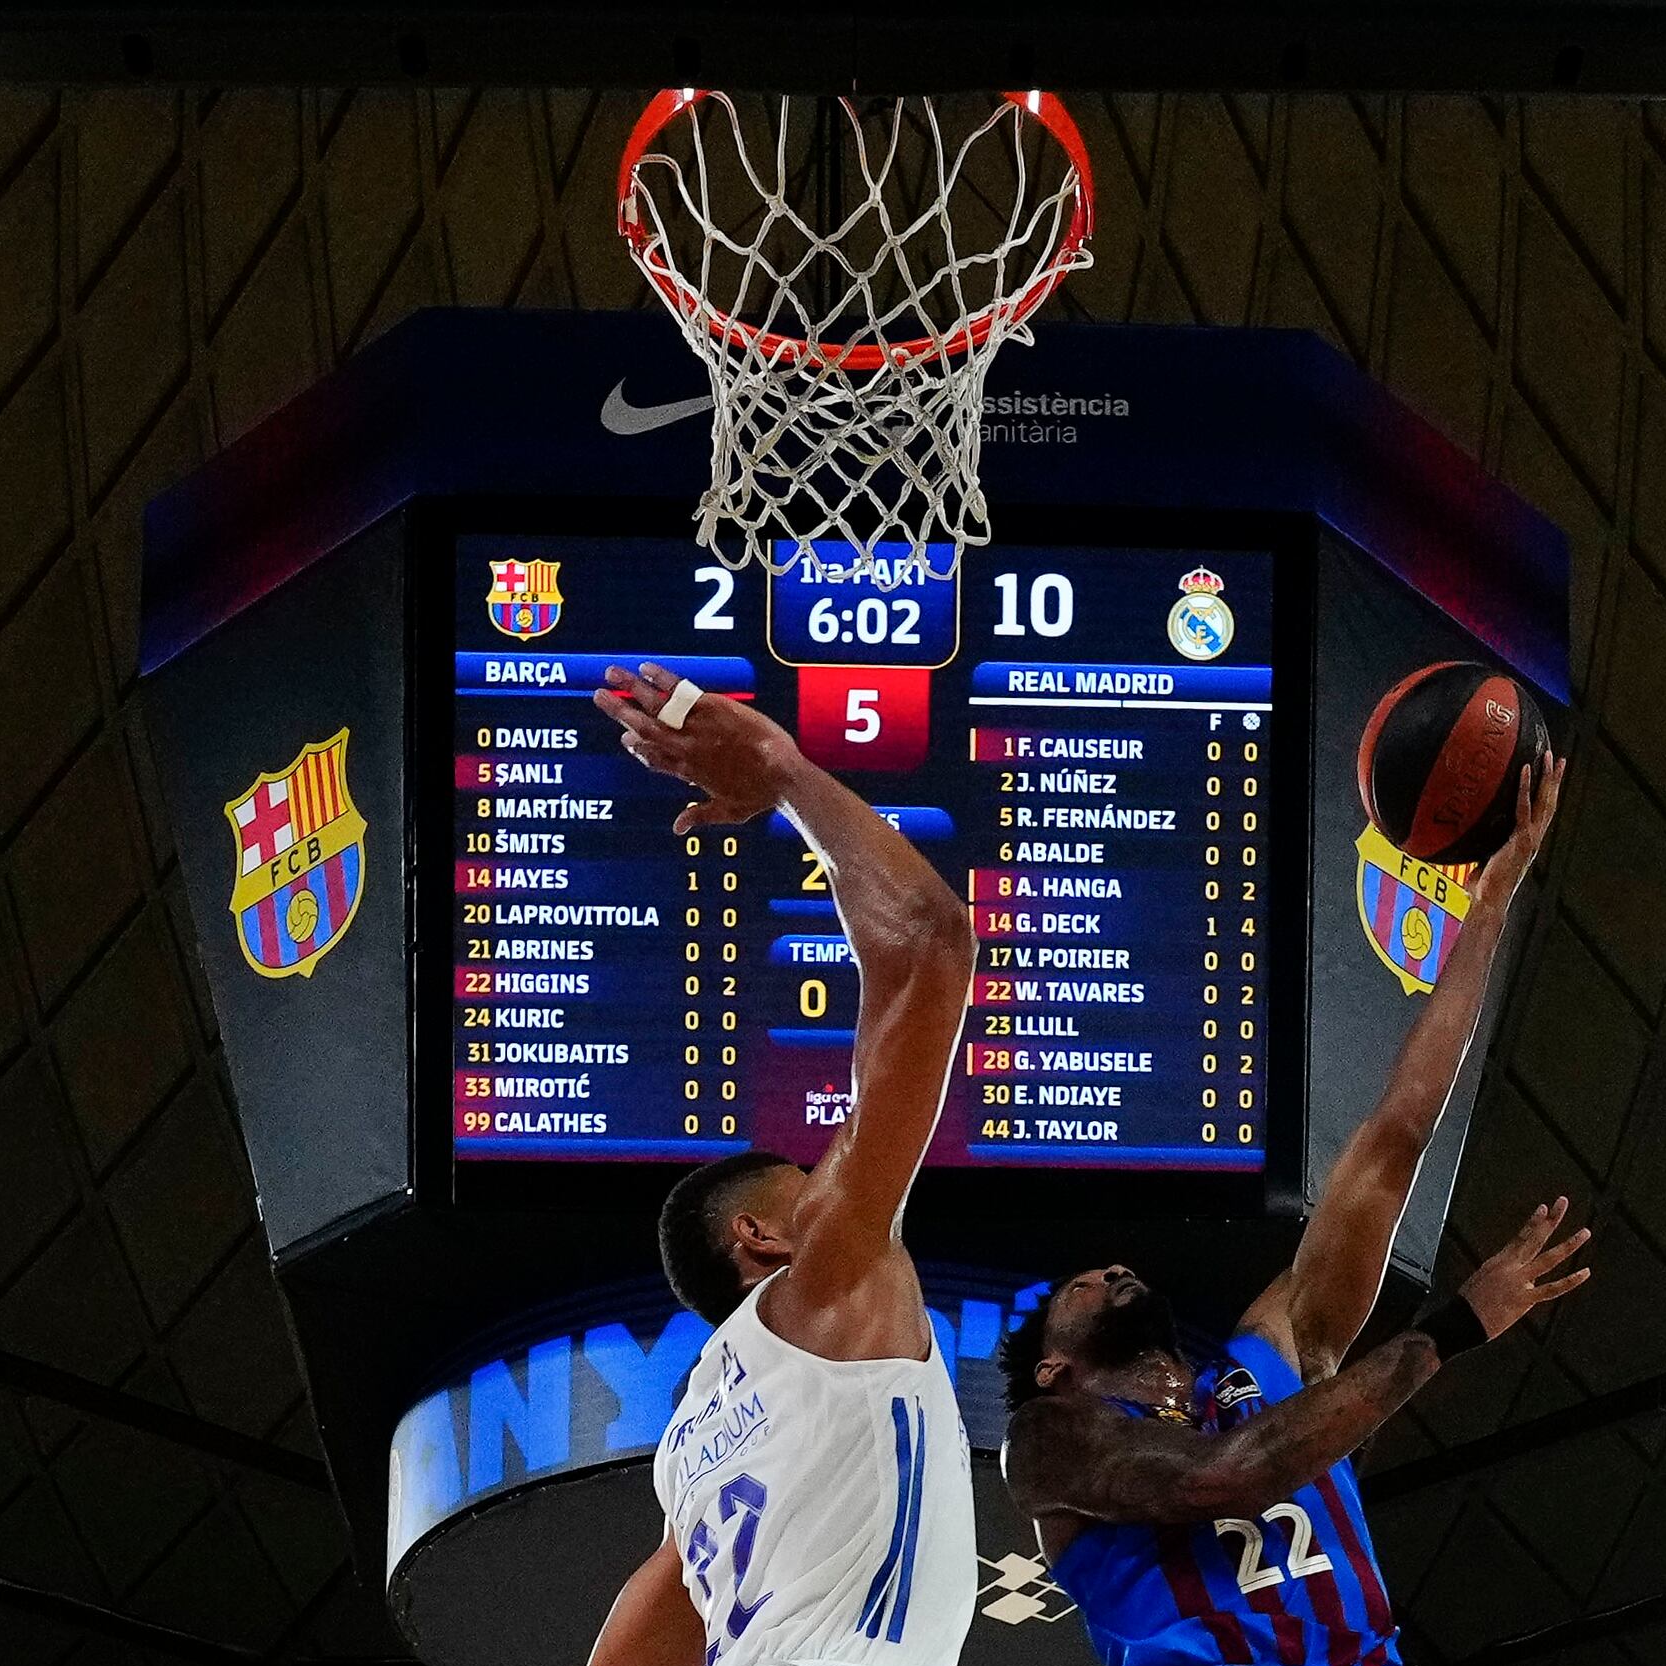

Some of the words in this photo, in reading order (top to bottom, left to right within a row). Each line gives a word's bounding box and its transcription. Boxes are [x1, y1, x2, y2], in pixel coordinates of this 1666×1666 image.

[983, 390, 1129, 417] ssistència
[981, 418, 1078, 444] anitària
[853, 558, 931, 585] PART
[693, 567, 735, 629] 2
[993, 573, 1073, 637] 10
[808, 598, 921, 644] 6:02
[485, 661, 567, 687] BARÇA
[1008, 671, 1070, 693] REAL
[1076, 672, 1174, 695] MADRID
[845, 689, 881, 743] 5
[1209, 714, 1222, 731] F
[477, 728, 491, 747] 0
[495, 729, 578, 748] DAVIES
[1004, 738, 1013, 756] 1
[1018, 738, 1035, 757] F.
[1039, 739, 1144, 760] CAUSEUR
[1207, 743, 1221, 761] 0
[1244, 744, 1258, 761] 0
[478, 764, 491, 782] 5
[495, 763, 563, 787] ŞANLI
[1000, 773, 1013, 792] 2
[1018, 773, 1035, 793] J.
[1040, 768, 1116, 794] NÚÑEZ
[1207, 778, 1220, 796] 0
[1243, 778, 1257, 797] 0
[477, 799, 491, 818] 8
[495, 795, 613, 820] MARTÍNEZ
[1000, 808, 1013, 826] 5
[1018, 808, 1037, 827] R.
[1043, 804, 1176, 830] FERNÁNDEZ
[1206, 812, 1220, 831] 0
[1243, 813, 1257, 832] 0
[467, 834, 491, 853] 10
[495, 829, 565, 854] ŠMITS
[686, 837, 699, 856] 0
[723, 837, 737, 856] 0
[999, 843, 1013, 861] 6
[1016, 843, 1104, 864] ABALDE
[1206, 846, 1219, 865] 0
[1243, 847, 1256, 866] 0
[270, 836, 322, 888] FCB
[801, 852, 830, 891] 2
[467, 869, 491, 888] 14
[495, 869, 568, 889] HAYES
[688, 873, 698, 891] 1
[723, 873, 737, 892] 0
[998, 877, 1012, 896] 8
[1015, 878, 1037, 897] A.
[1043, 878, 1122, 898] HANGA
[1205, 881, 1219, 900] 0
[1243, 882, 1255, 900] 2
[1399, 853, 1449, 904] FCB
[464, 904, 491, 924] 20
[495, 905, 659, 927] LAPROVITTOLA
[686, 908, 699, 927] 0
[723, 909, 737, 927] 0
[988, 913, 1012, 931] 14
[1015, 913, 1037, 932] G.
[1042, 914, 1100, 934] DECK
[1206, 917, 1216, 936] 1
[1241, 918, 1256, 936] 4
[468, 940, 491, 959] 21
[495, 940, 594, 961] ABRINES
[686, 943, 699, 962] 0
[723, 943, 737, 962] 0
[989, 947, 1011, 966] 17
[1015, 948, 1034, 968] V.
[1039, 949, 1130, 969] POIRIER
[1204, 952, 1218, 971] 0
[1241, 952, 1255, 971] 0
[465, 974, 491, 993] 22
[495, 974, 589, 994] HIGGINS
[685, 977, 699, 996] 0
[723, 977, 736, 996] 2
[986, 981, 1011, 1000] 22
[1015, 982, 1042, 1002] W.
[1045, 982, 1144, 1002] TAVARES
[1204, 985, 1217, 1004] 0
[1241, 987, 1253, 1005] 2
[800, 978, 828, 1019] 0
[464, 1008, 491, 1028] 24
[495, 1008, 564, 1029] KURIC
[685, 1012, 699, 1030] 0
[722, 1012, 736, 1031] 0
[985, 1016, 1010, 1035] 23
[1015, 1016, 1079, 1036] LLULL
[1203, 1020, 1217, 1039] 0
[1240, 1020, 1253, 1039] 0
[468, 1043, 491, 1062] 31
[494, 1043, 629, 1064] JOKUBAITIS
[685, 1047, 698, 1065] 0
[722, 1047, 736, 1065] 0
[983, 1051, 1009, 1070] 28
[1014, 1051, 1035, 1071] G.
[1040, 1052, 1152, 1072] YABUSELE
[1202, 1054, 1216, 1073] 0
[1240, 1055, 1253, 1074] 2
[465, 1078, 491, 1096] 33
[495, 1073, 590, 1099] MIROTIĆ
[983, 1086, 1009, 1104] 30
[1014, 1086, 1033, 1105] E.
[1039, 1086, 1121, 1107] NDIAYE
[1202, 1089, 1216, 1108] 0
[1239, 1090, 1252, 1109] 0
[464, 1113, 491, 1132] 99
[495, 1113, 607, 1134] CALATHES
[806, 1105, 852, 1125] PLA
[982, 1120, 1009, 1138] 44
[1013, 1120, 1033, 1140] J.
[1036, 1121, 1118, 1141] TAYLOR
[1213, 1502, 1333, 1594] 22
